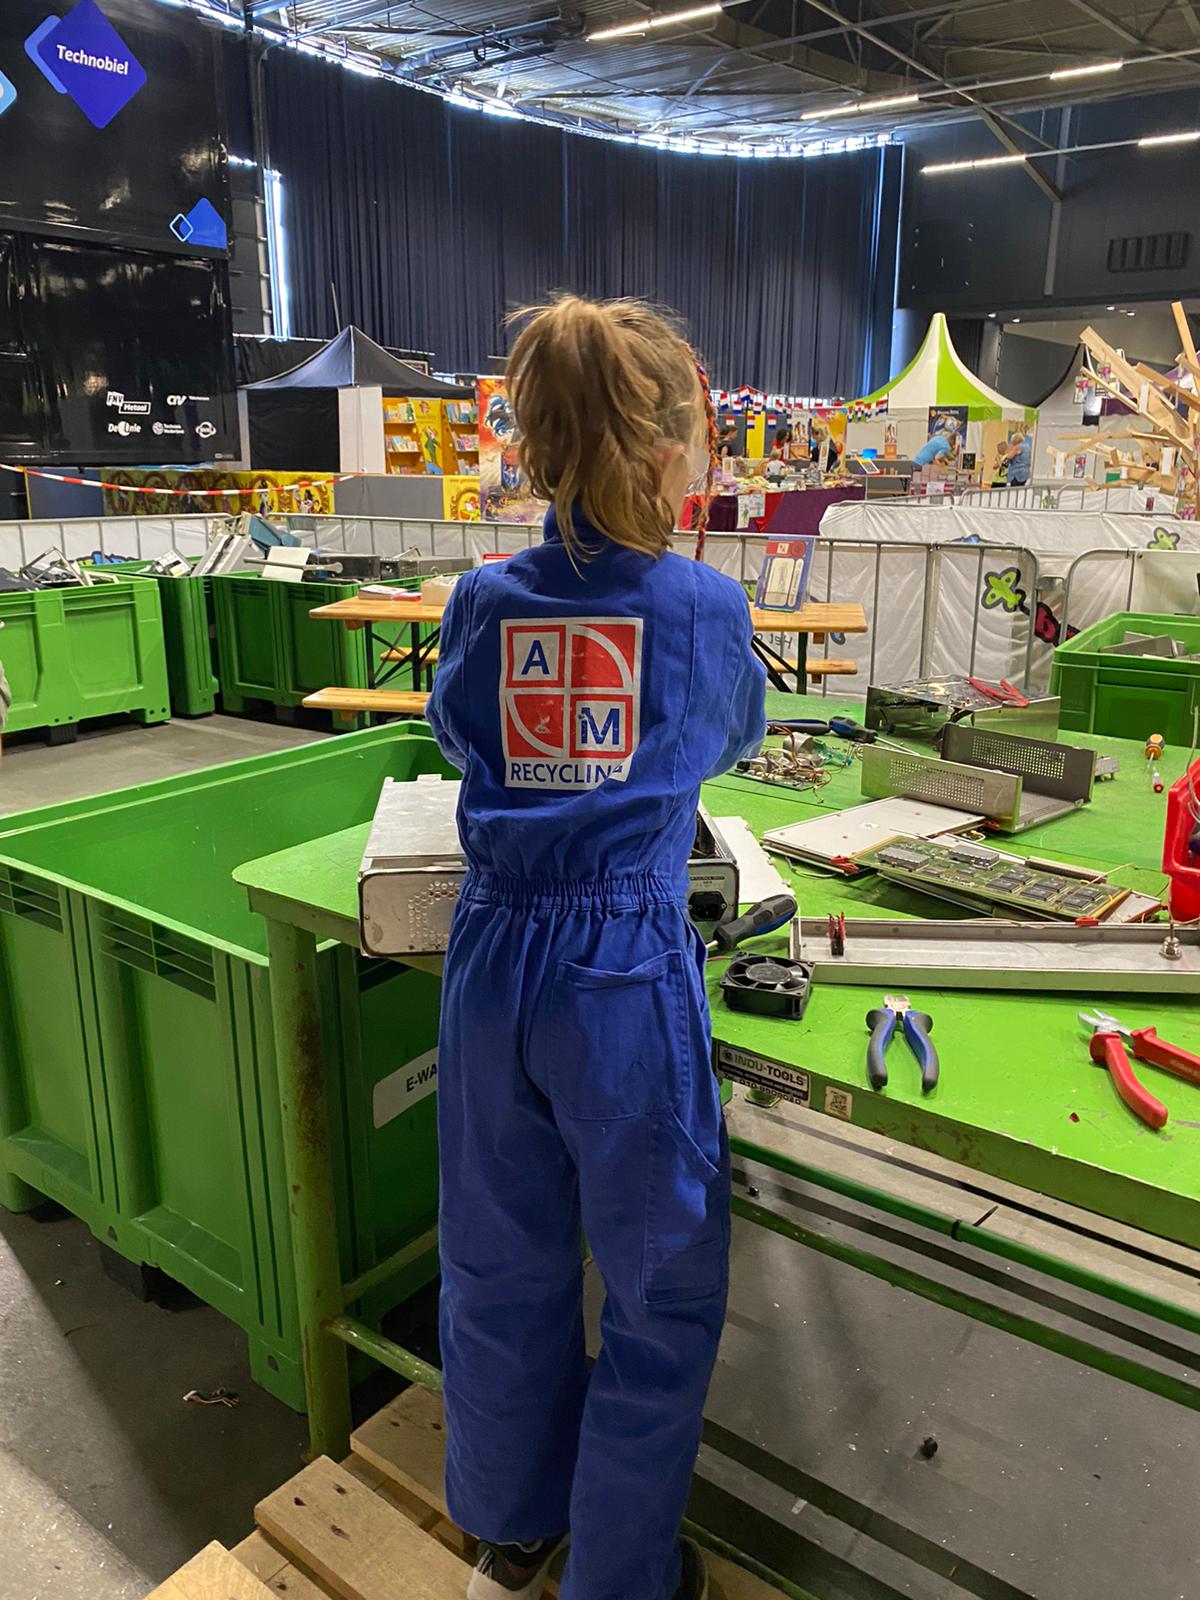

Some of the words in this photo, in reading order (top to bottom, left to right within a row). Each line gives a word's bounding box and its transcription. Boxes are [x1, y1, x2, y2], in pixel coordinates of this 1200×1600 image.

[56, 44, 129, 75] Technobiel
[521, 640, 550, 675] A
[580, 707, 620, 746] M
[406, 1063, 437, 1093] E-WA
[734, 1054, 805, 1086] INDU-TOOLS
